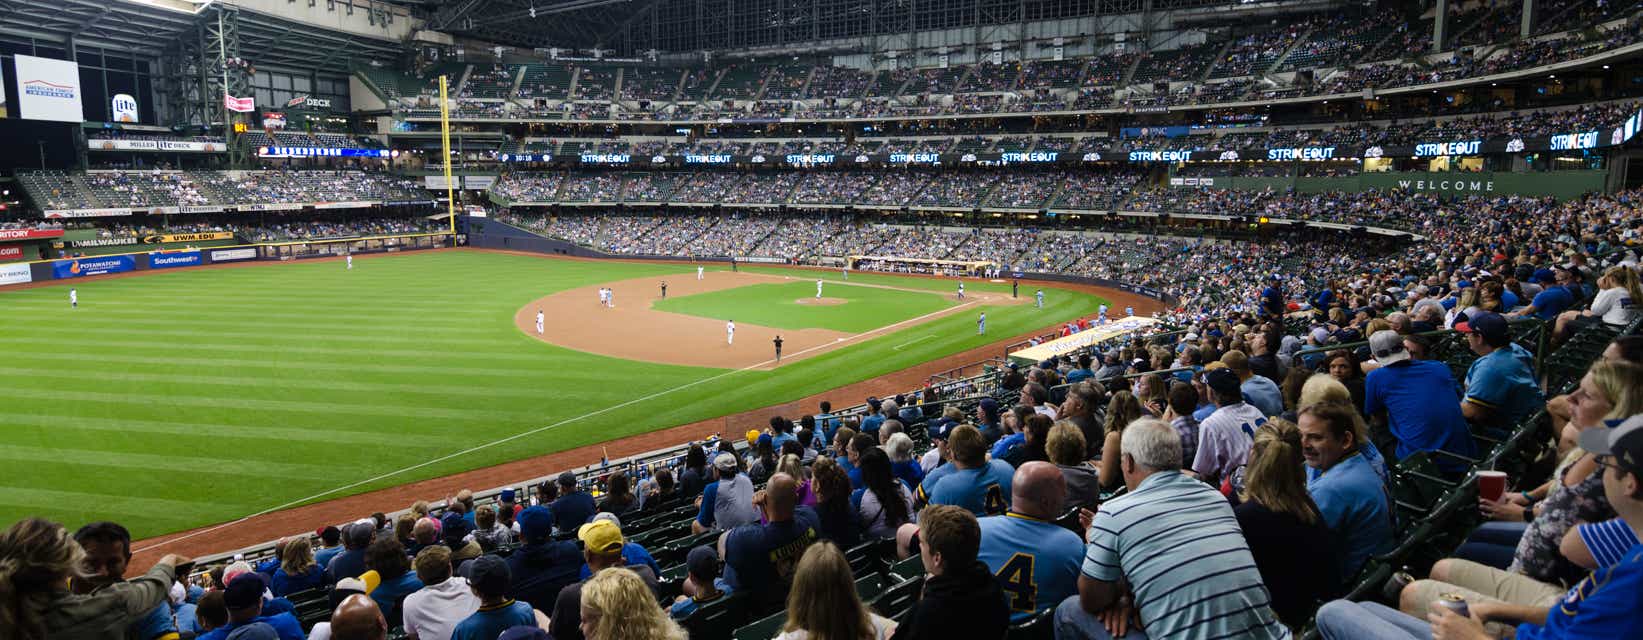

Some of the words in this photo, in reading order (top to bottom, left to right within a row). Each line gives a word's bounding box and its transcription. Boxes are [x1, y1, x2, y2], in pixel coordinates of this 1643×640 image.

[116, 99, 134, 112] Lite
[306, 98, 331, 107] DECK
[156, 140, 172, 150] Lite
[1551, 131, 1598, 150] STRIKEOUT
[1269, 148, 1335, 160] STRIKEOUT
[1415, 140, 1481, 157] STRIKEOUT
[581, 154, 630, 163] STRIKEOUT
[686, 154, 731, 163] STRIKEOUT
[786, 153, 834, 163] STRIKEOUT
[890, 153, 939, 162] STRIKEOUT
[1001, 152, 1058, 162] STRIKEOUT
[1129, 150, 1191, 162] STRIKEOUT
[1399, 180, 1494, 192] WELCOME
[154, 254, 194, 265] Southwest
[994, 551, 1038, 614] 4
